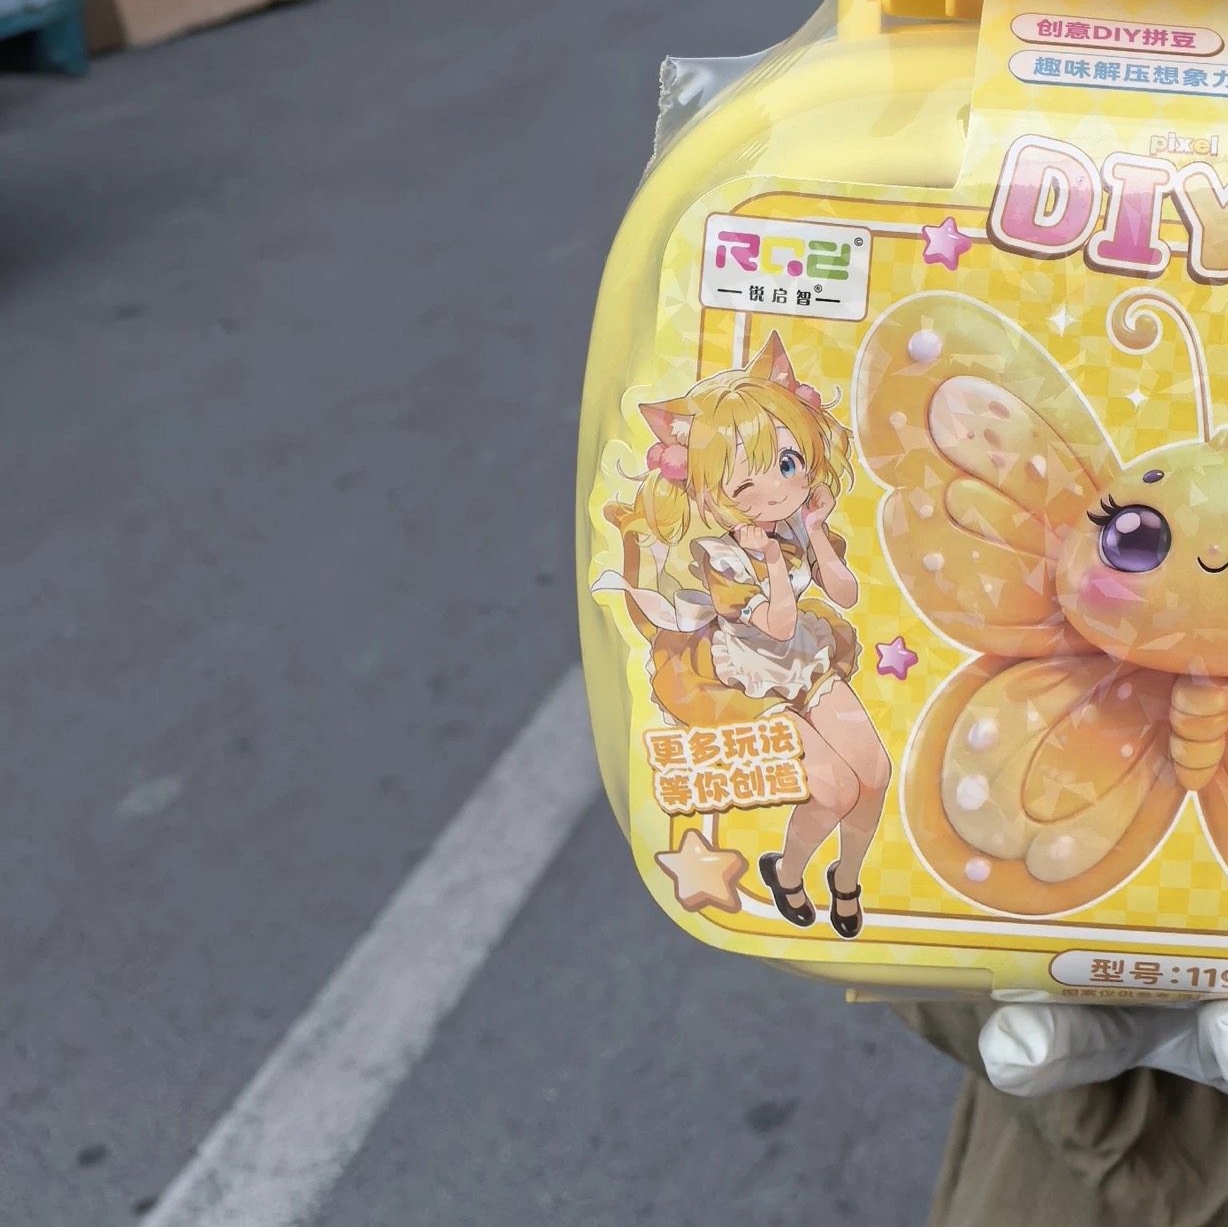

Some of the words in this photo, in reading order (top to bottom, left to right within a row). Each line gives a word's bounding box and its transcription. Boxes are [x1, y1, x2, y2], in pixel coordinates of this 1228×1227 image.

[1036, 18, 1197, 49] 创意DIY拼豆
[1150, 132, 1219, 156] pixel
[651, 722, 796, 765] 更多玩法
[660, 763, 801, 805] 等你创造
